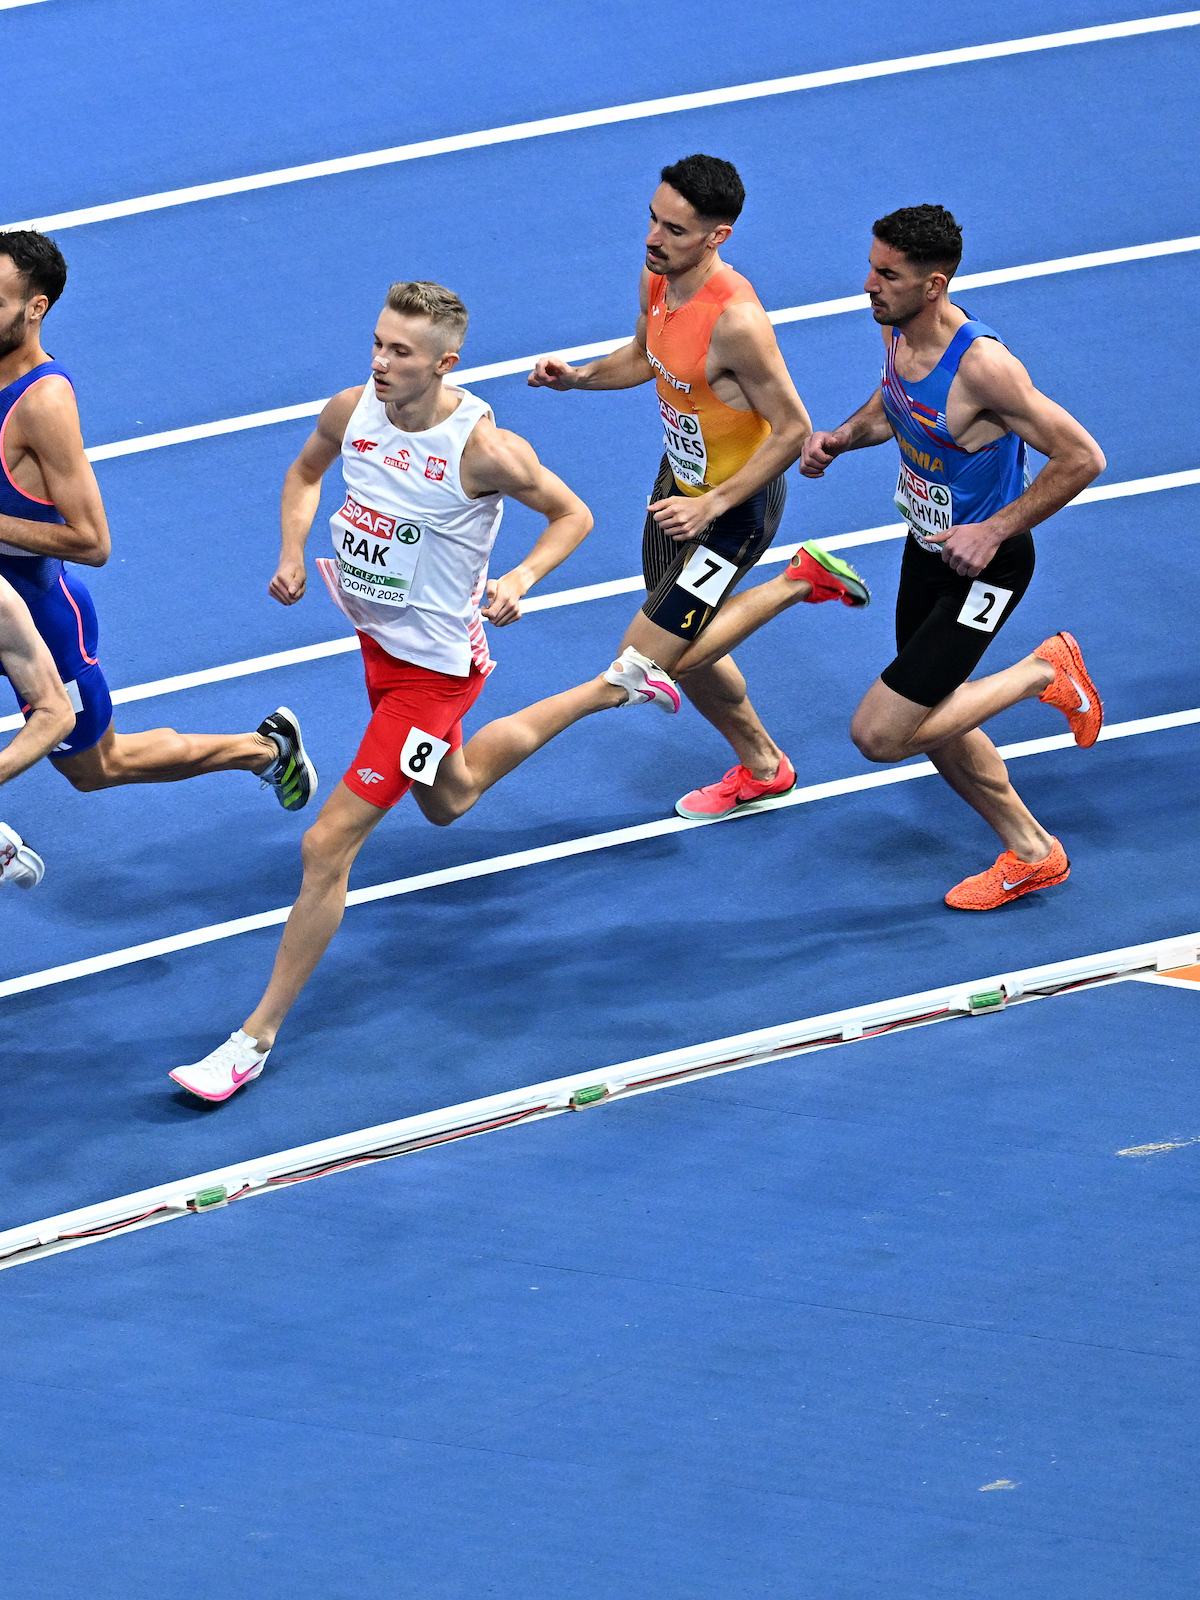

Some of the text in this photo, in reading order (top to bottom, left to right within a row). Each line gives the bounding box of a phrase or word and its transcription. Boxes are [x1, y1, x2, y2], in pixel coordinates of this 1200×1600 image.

[352, 438, 378, 453] 4F
[385, 458, 409, 470] ORLEN
[342, 500, 393, 537] SPAR
[342, 529, 390, 567] RAK
[354, 568, 386, 584] CLEAN
[692, 558, 722, 588] 7
[377, 589, 404, 602] 2025
[973, 592, 996, 624] 2
[408, 741, 433, 773] 8
[357, 767, 385, 785] 4F
